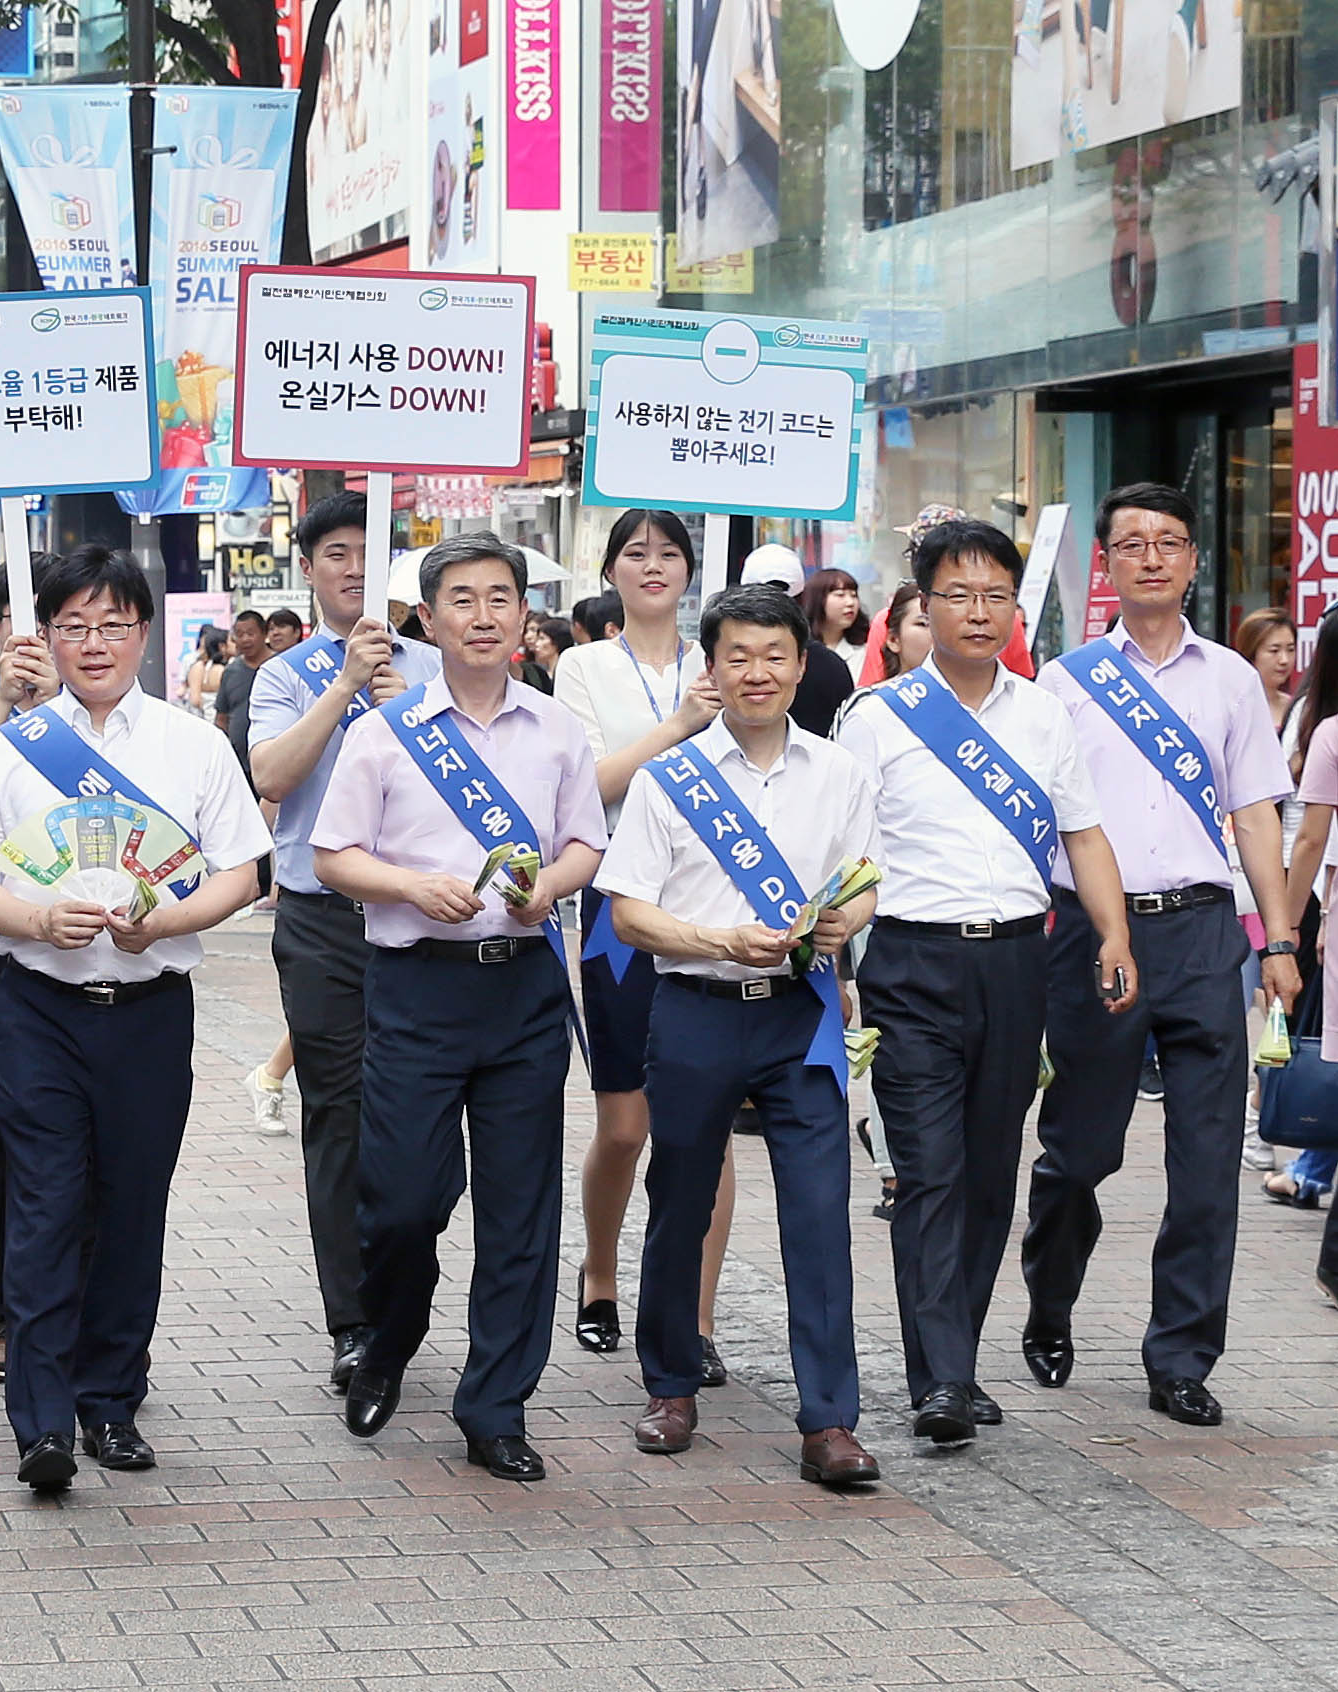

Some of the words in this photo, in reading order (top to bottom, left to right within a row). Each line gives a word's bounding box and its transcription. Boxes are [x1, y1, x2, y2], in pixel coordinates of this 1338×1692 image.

[37, 256, 111, 273] SUMMER
[575, 250, 645, 274] 부동산
[175, 276, 235, 303] SAL
[261, 286, 387, 302] 절전캠페인시민단체협의회
[264, 339, 339, 371] 에너지
[348, 343, 400, 373] 사용
[407, 346, 504, 374] DOWN!
[31, 368, 88, 395] 1등급
[94, 365, 140, 392] 제품
[278, 380, 381, 411] 온실가스
[389, 386, 486, 414] DOWN!
[3, 404, 83, 433] 부탁해!
[615, 401, 690, 429] 사용하지
[696, 406, 733, 432] 않는
[737, 409, 774, 435] 전기
[779, 412, 835, 439] 코드는
[670, 437, 776, 467] 뽑아주세요!
[1296, 471, 1320, 673] SALE
[1090, 657, 1161, 730] 에너지
[1154, 727, 1204, 782] 사용
[401, 700, 468, 780] 에너지
[461, 779, 514, 838] 사용
[956, 739, 1051, 846] 온실가스
[711, 809, 764, 870] 사용
